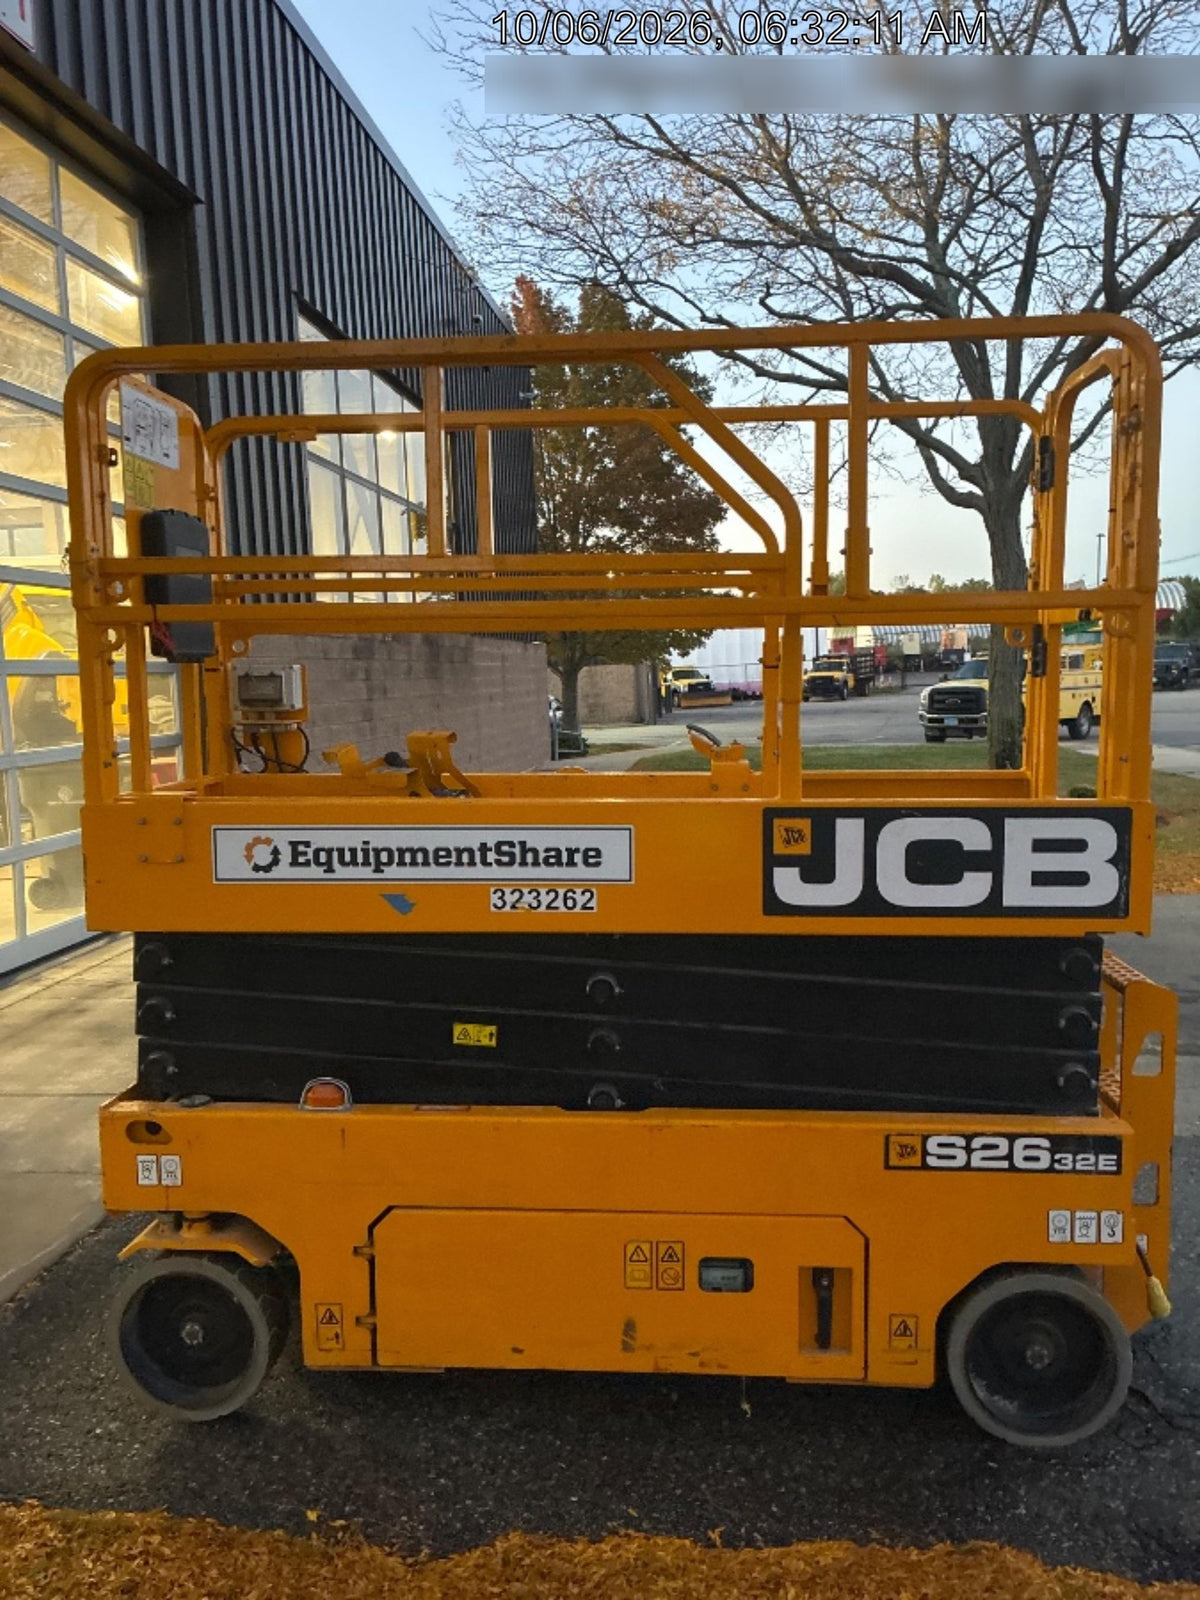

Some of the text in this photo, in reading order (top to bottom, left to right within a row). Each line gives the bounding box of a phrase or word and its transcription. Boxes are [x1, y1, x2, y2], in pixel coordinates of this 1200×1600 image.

[287, 839, 603, 874] EquipmentShare
[772, 817, 1120, 907] JCB
[491, 888, 596, 911] 323262
[925, 1135, 1118, 1171] S26 32E
